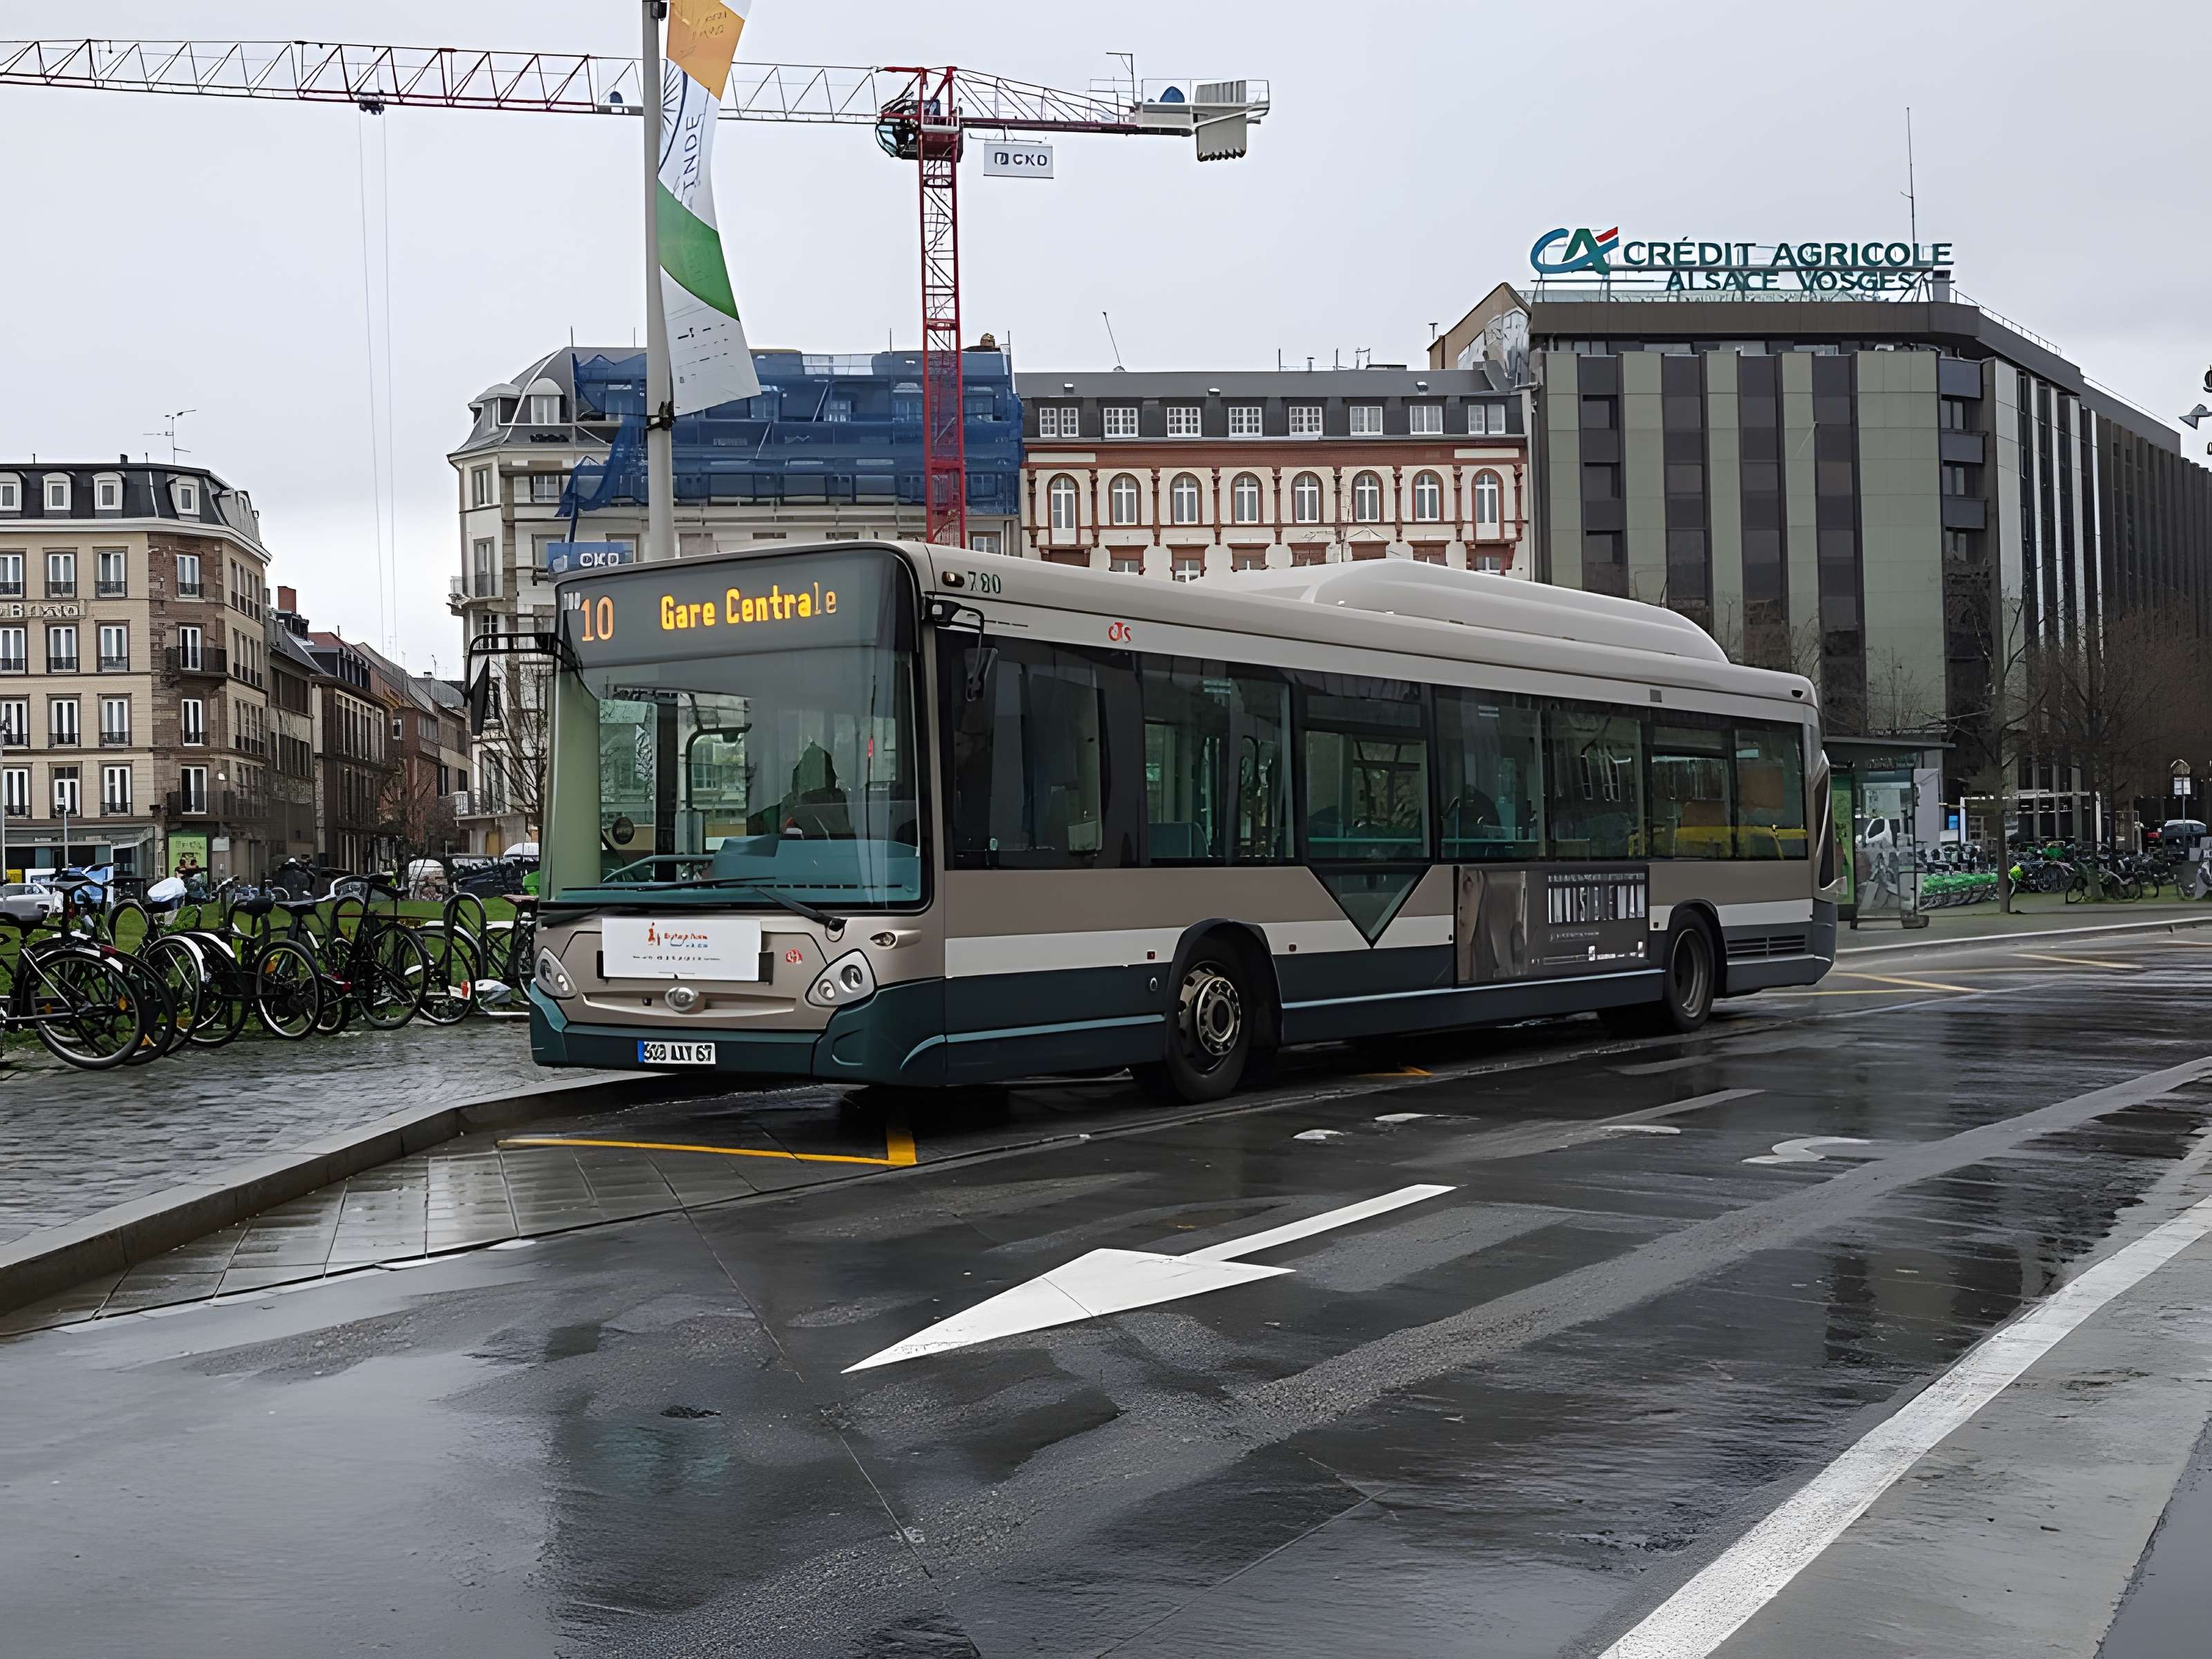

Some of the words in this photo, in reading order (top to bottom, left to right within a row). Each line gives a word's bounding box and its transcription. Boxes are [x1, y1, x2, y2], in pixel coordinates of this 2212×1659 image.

[1624, 236, 1756, 266] CRÉDIT
[1770, 242, 1954, 267] AGRICOLE
[1665, 270, 1780, 291] ALSACE
[1796, 270, 1918, 292] VOSGES
[581, 595, 615, 641] 10
[660, 594, 717, 630] Gare
[725, 581, 837, 624] Centrale
